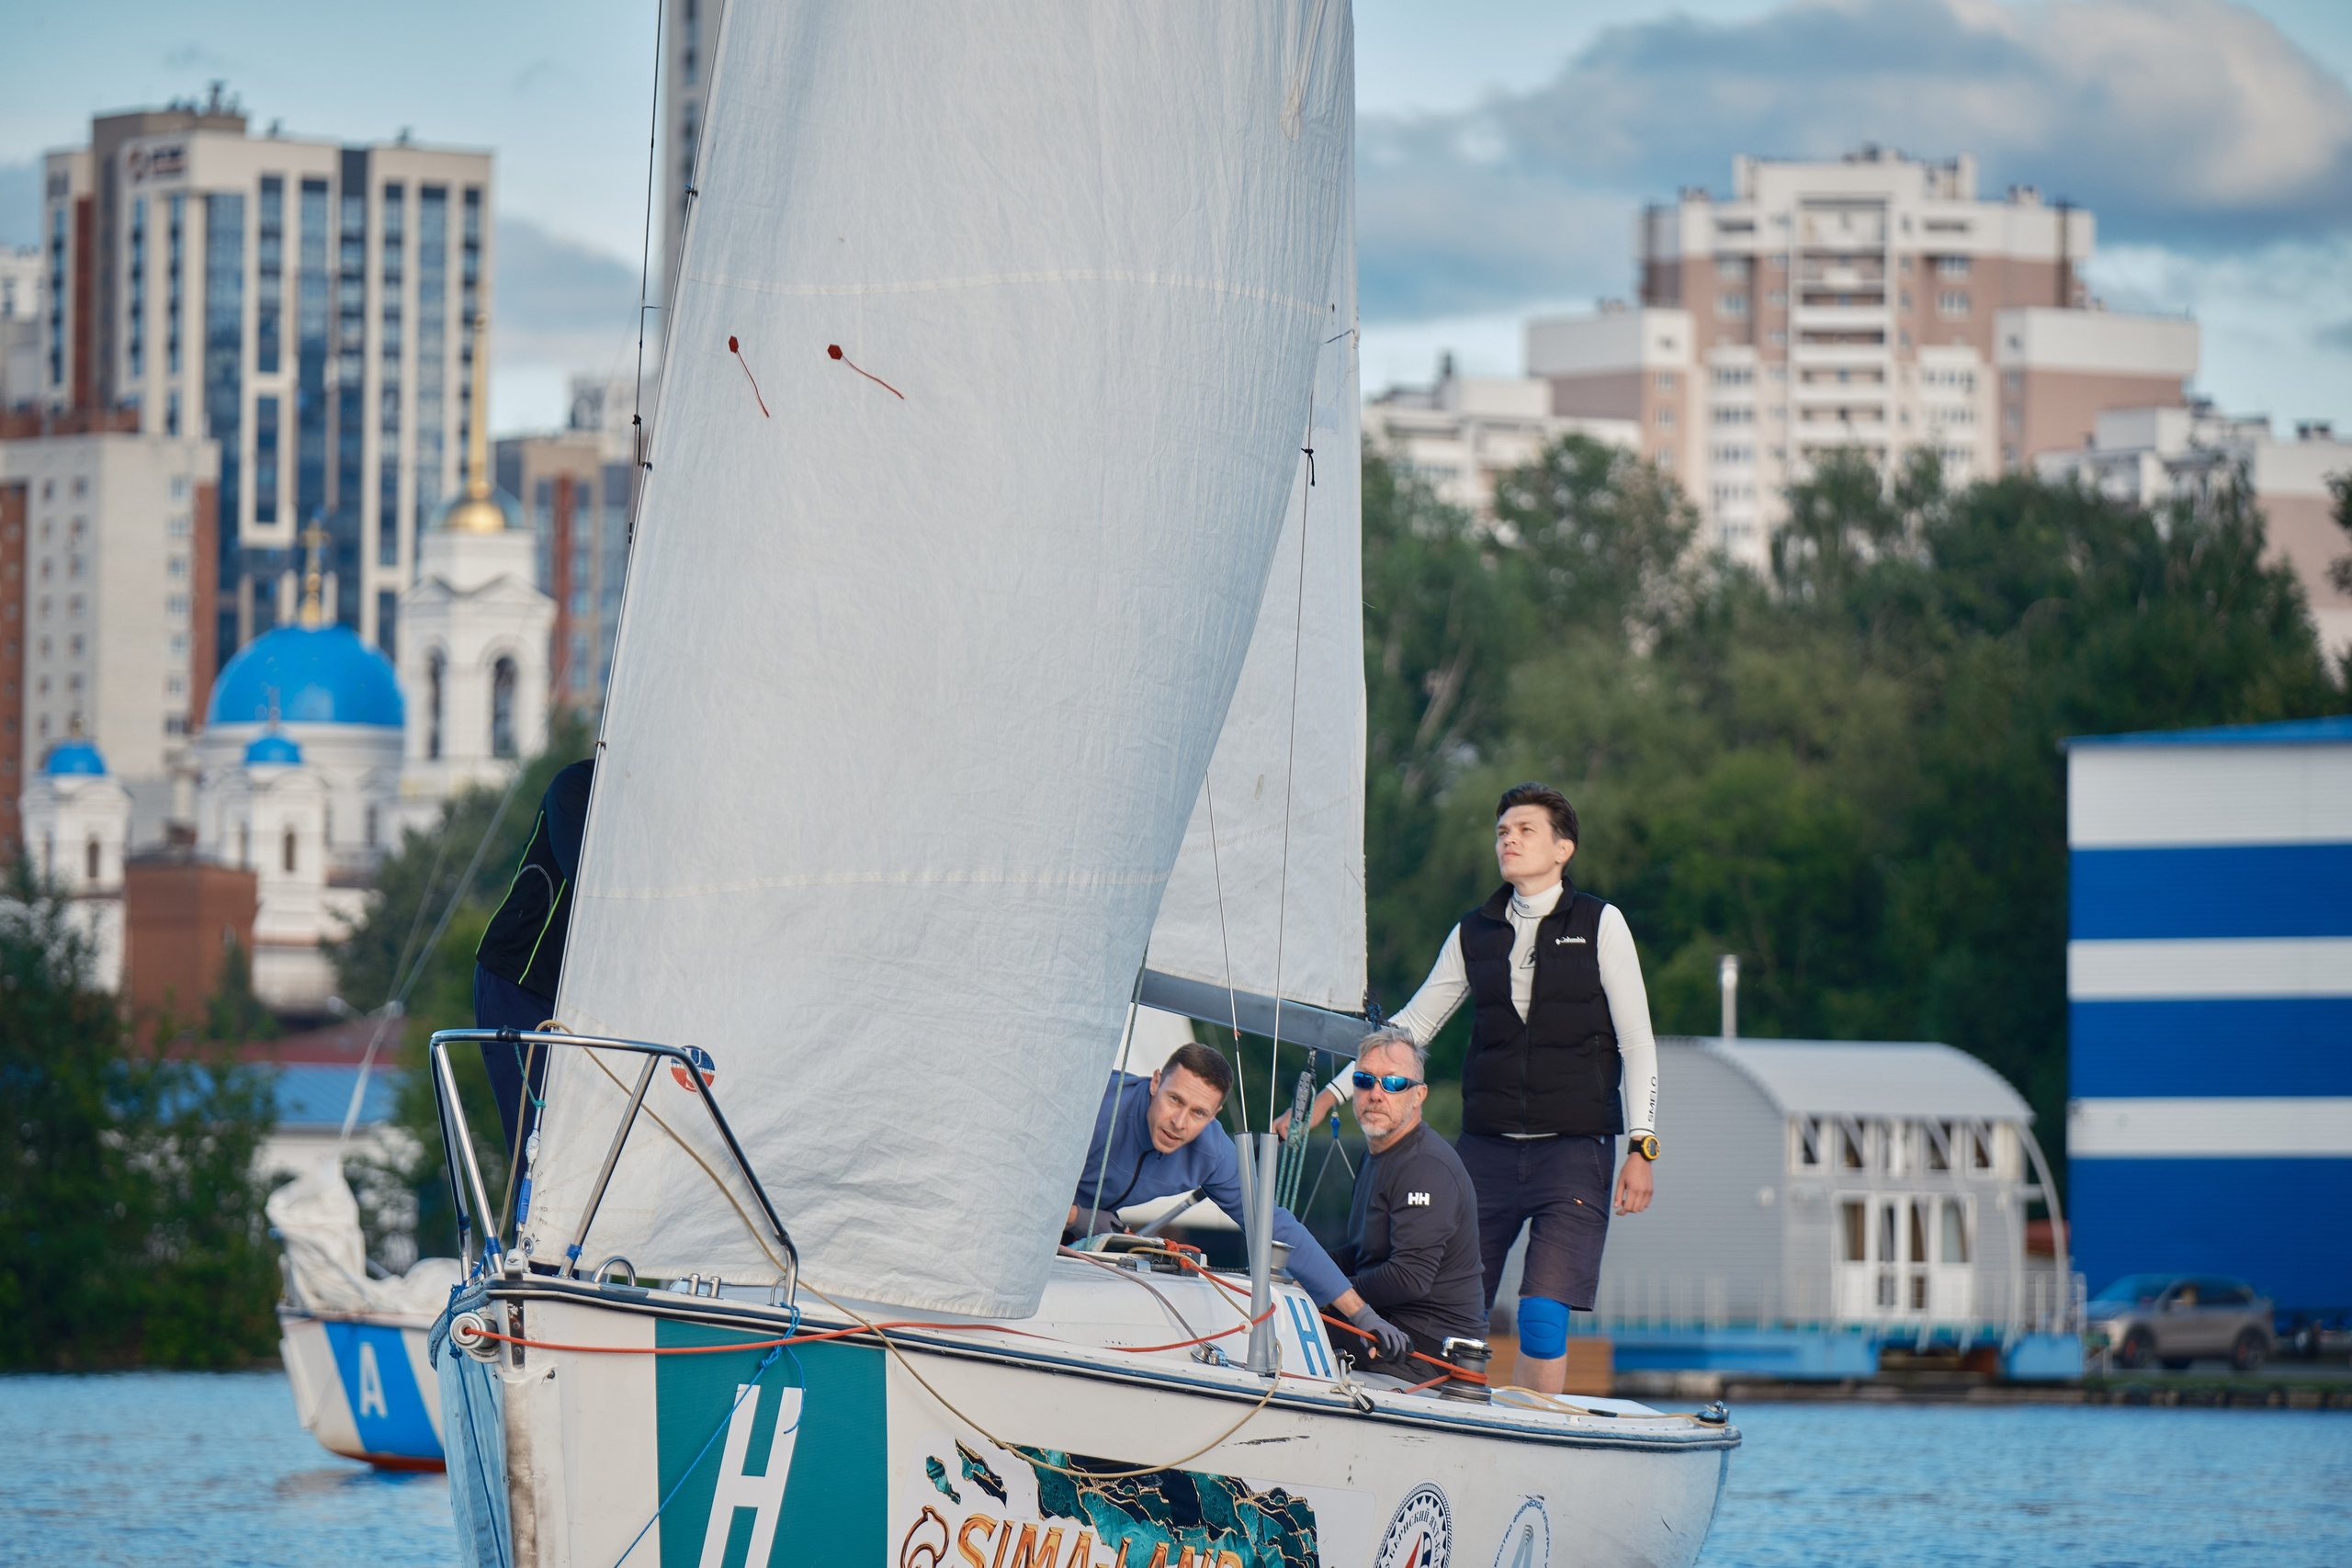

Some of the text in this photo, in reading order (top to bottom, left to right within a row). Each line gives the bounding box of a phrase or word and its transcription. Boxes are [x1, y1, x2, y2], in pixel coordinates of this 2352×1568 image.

[1408, 1191, 1430, 1206] HH
[1283, 1295, 1333, 1379] H
[359, 1341, 389, 1419] A
[698, 1383, 806, 1568] H
